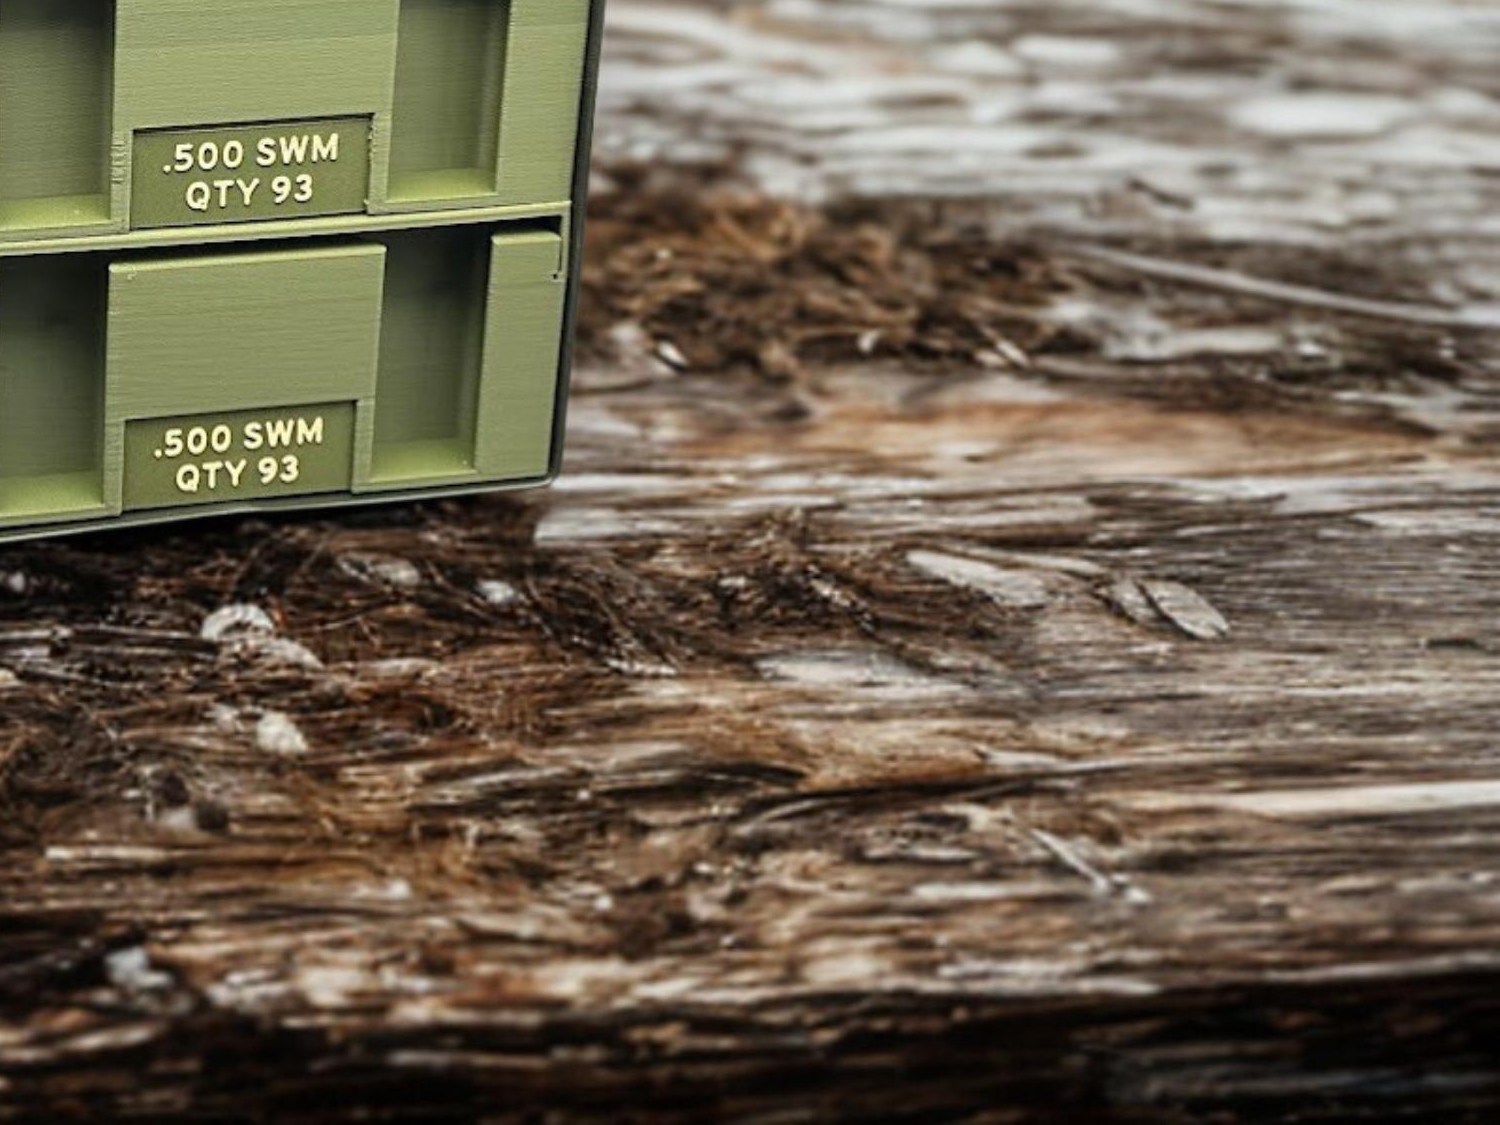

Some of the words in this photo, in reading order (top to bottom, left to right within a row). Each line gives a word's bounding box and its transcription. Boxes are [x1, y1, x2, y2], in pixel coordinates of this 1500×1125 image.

[162, 139, 245, 173] .500
[255, 131, 340, 167] SWM
[184, 176, 261, 211] QTY
[270, 172, 314, 205] 93
[153, 423, 233, 459] .500
[242, 415, 325, 450] SWM
[175, 457, 248, 493] QTY
[256, 453, 300, 485] 93
